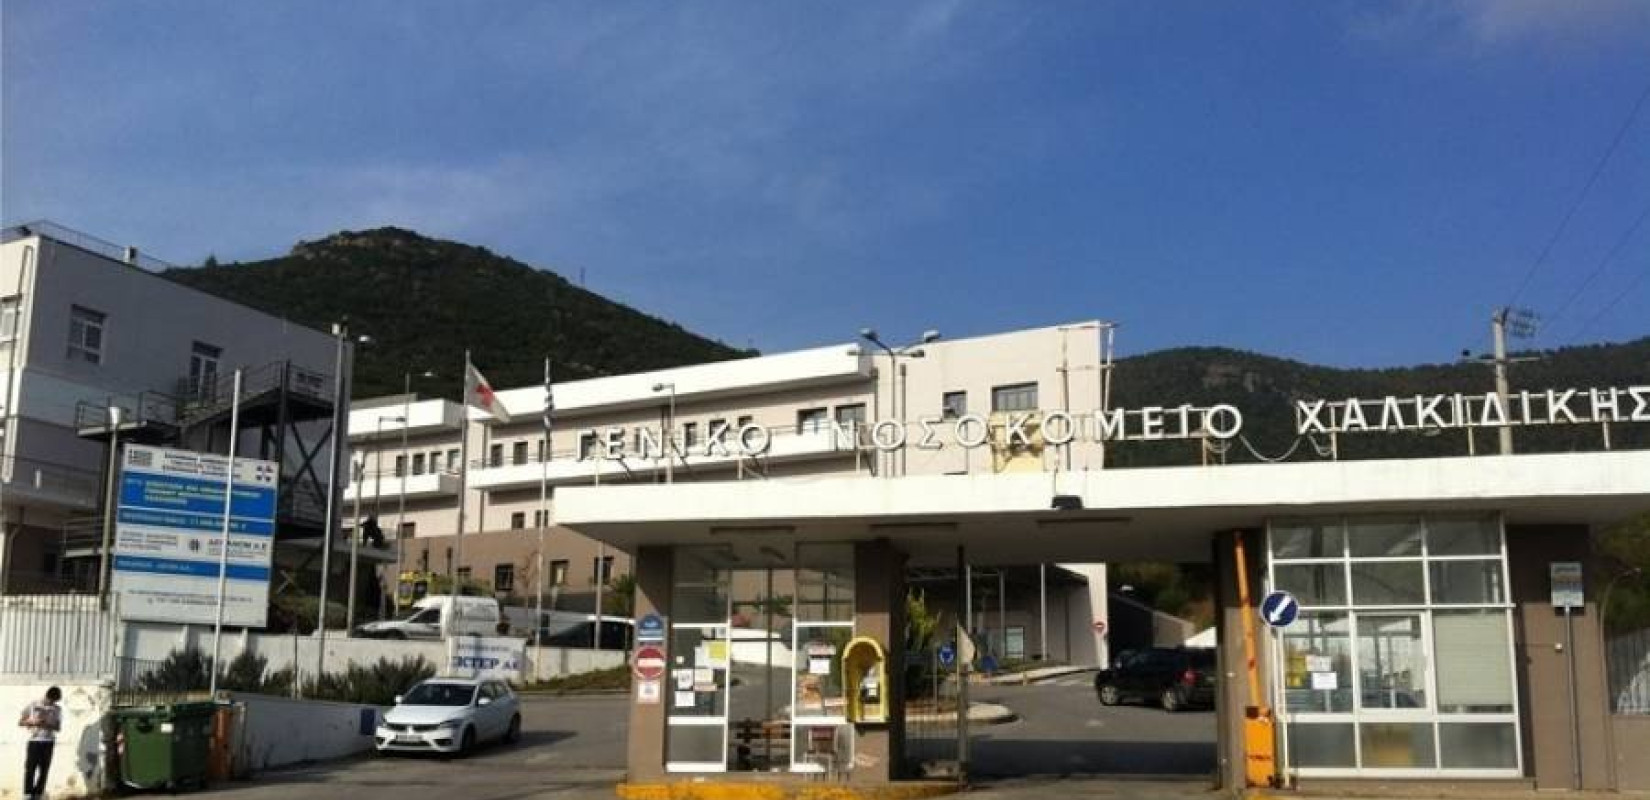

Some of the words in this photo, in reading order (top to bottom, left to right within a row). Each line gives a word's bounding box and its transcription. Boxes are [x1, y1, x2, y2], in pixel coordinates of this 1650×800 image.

[576, 421, 771, 461] ΓΕΝΙΚΟ
[832, 404, 1242, 451] ΝΟΣΟΚΟΜΕΙΟ
[1298, 387, 1650, 433] ΧΑΛΚΙΔΙΚΗΣ
